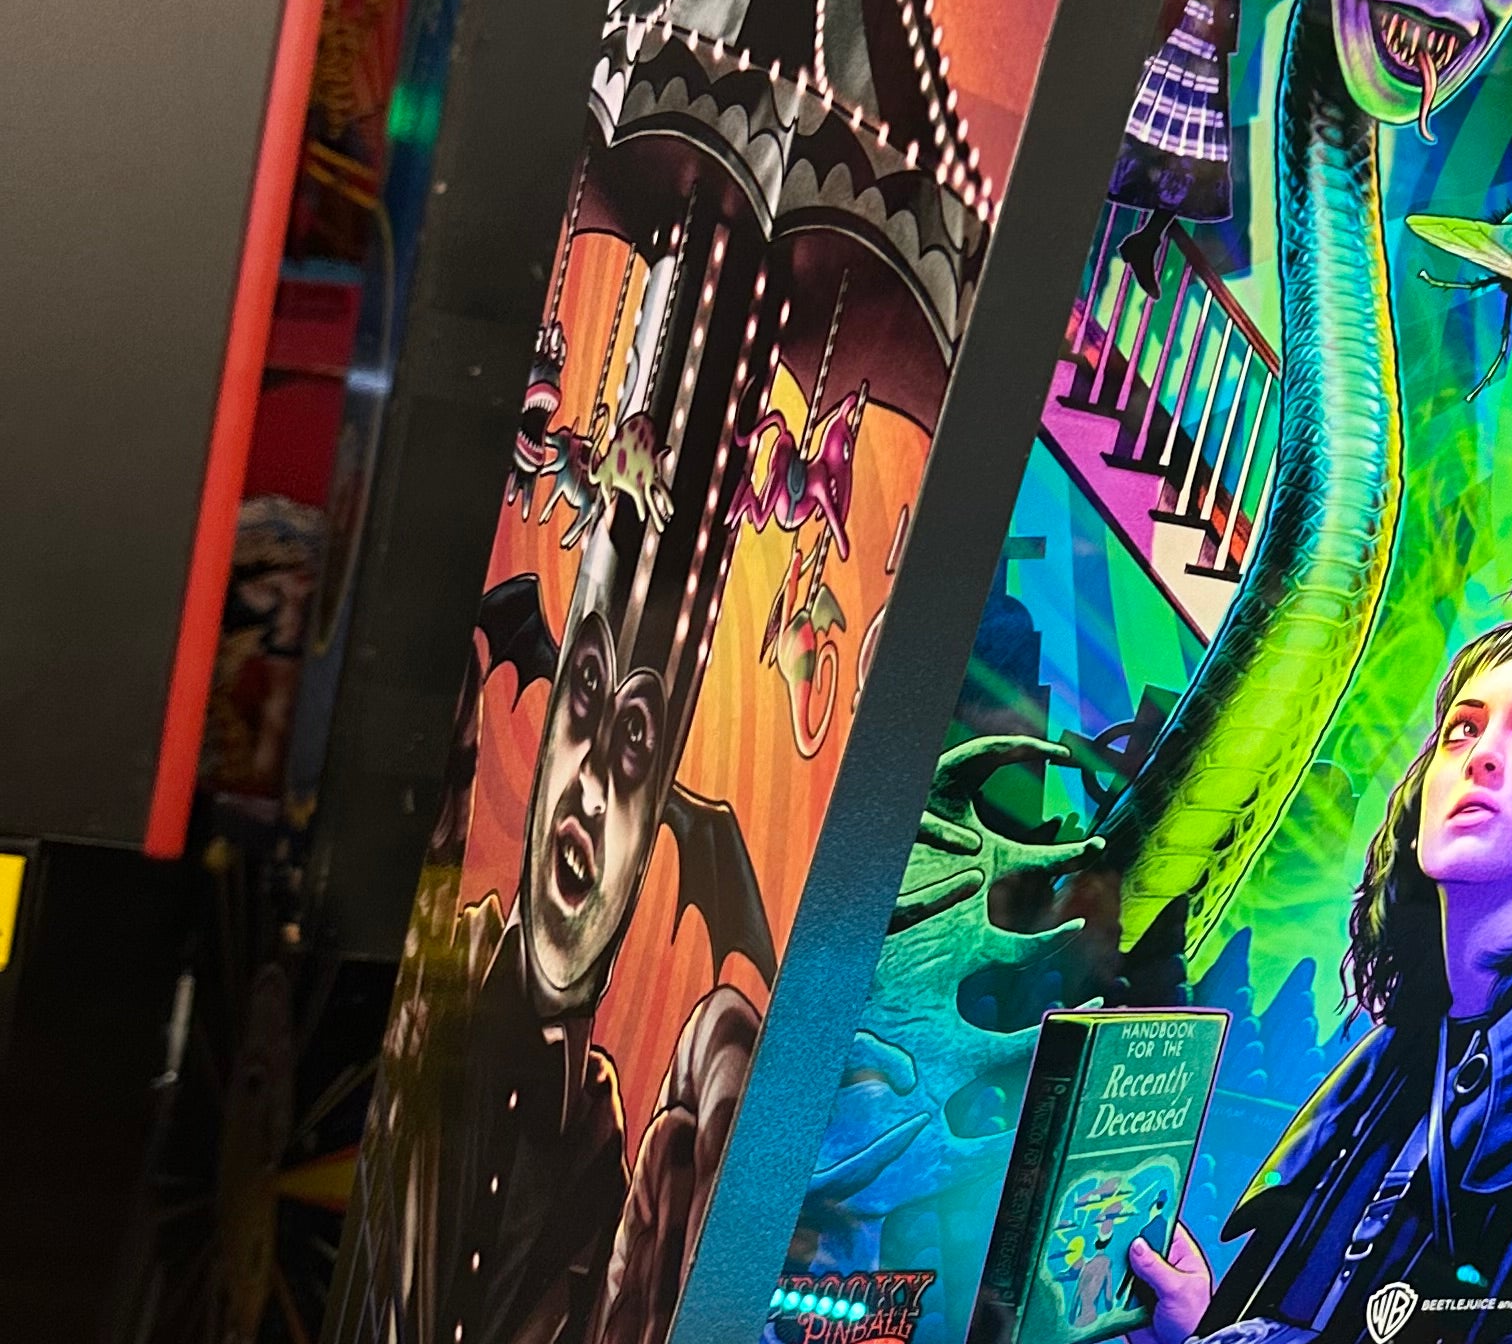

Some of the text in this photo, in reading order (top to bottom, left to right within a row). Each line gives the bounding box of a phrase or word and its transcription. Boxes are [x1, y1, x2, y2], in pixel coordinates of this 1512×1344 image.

[1121, 1022, 1197, 1040] HANDBOOK
[1127, 1041, 1183, 1059] FOR THE
[1102, 1062, 1194, 1106] Recently
[1086, 1097, 1194, 1140] Deceased
[1370, 1286, 1415, 1340] WB
[1421, 1298, 1497, 1312] BEETLEJUICE
